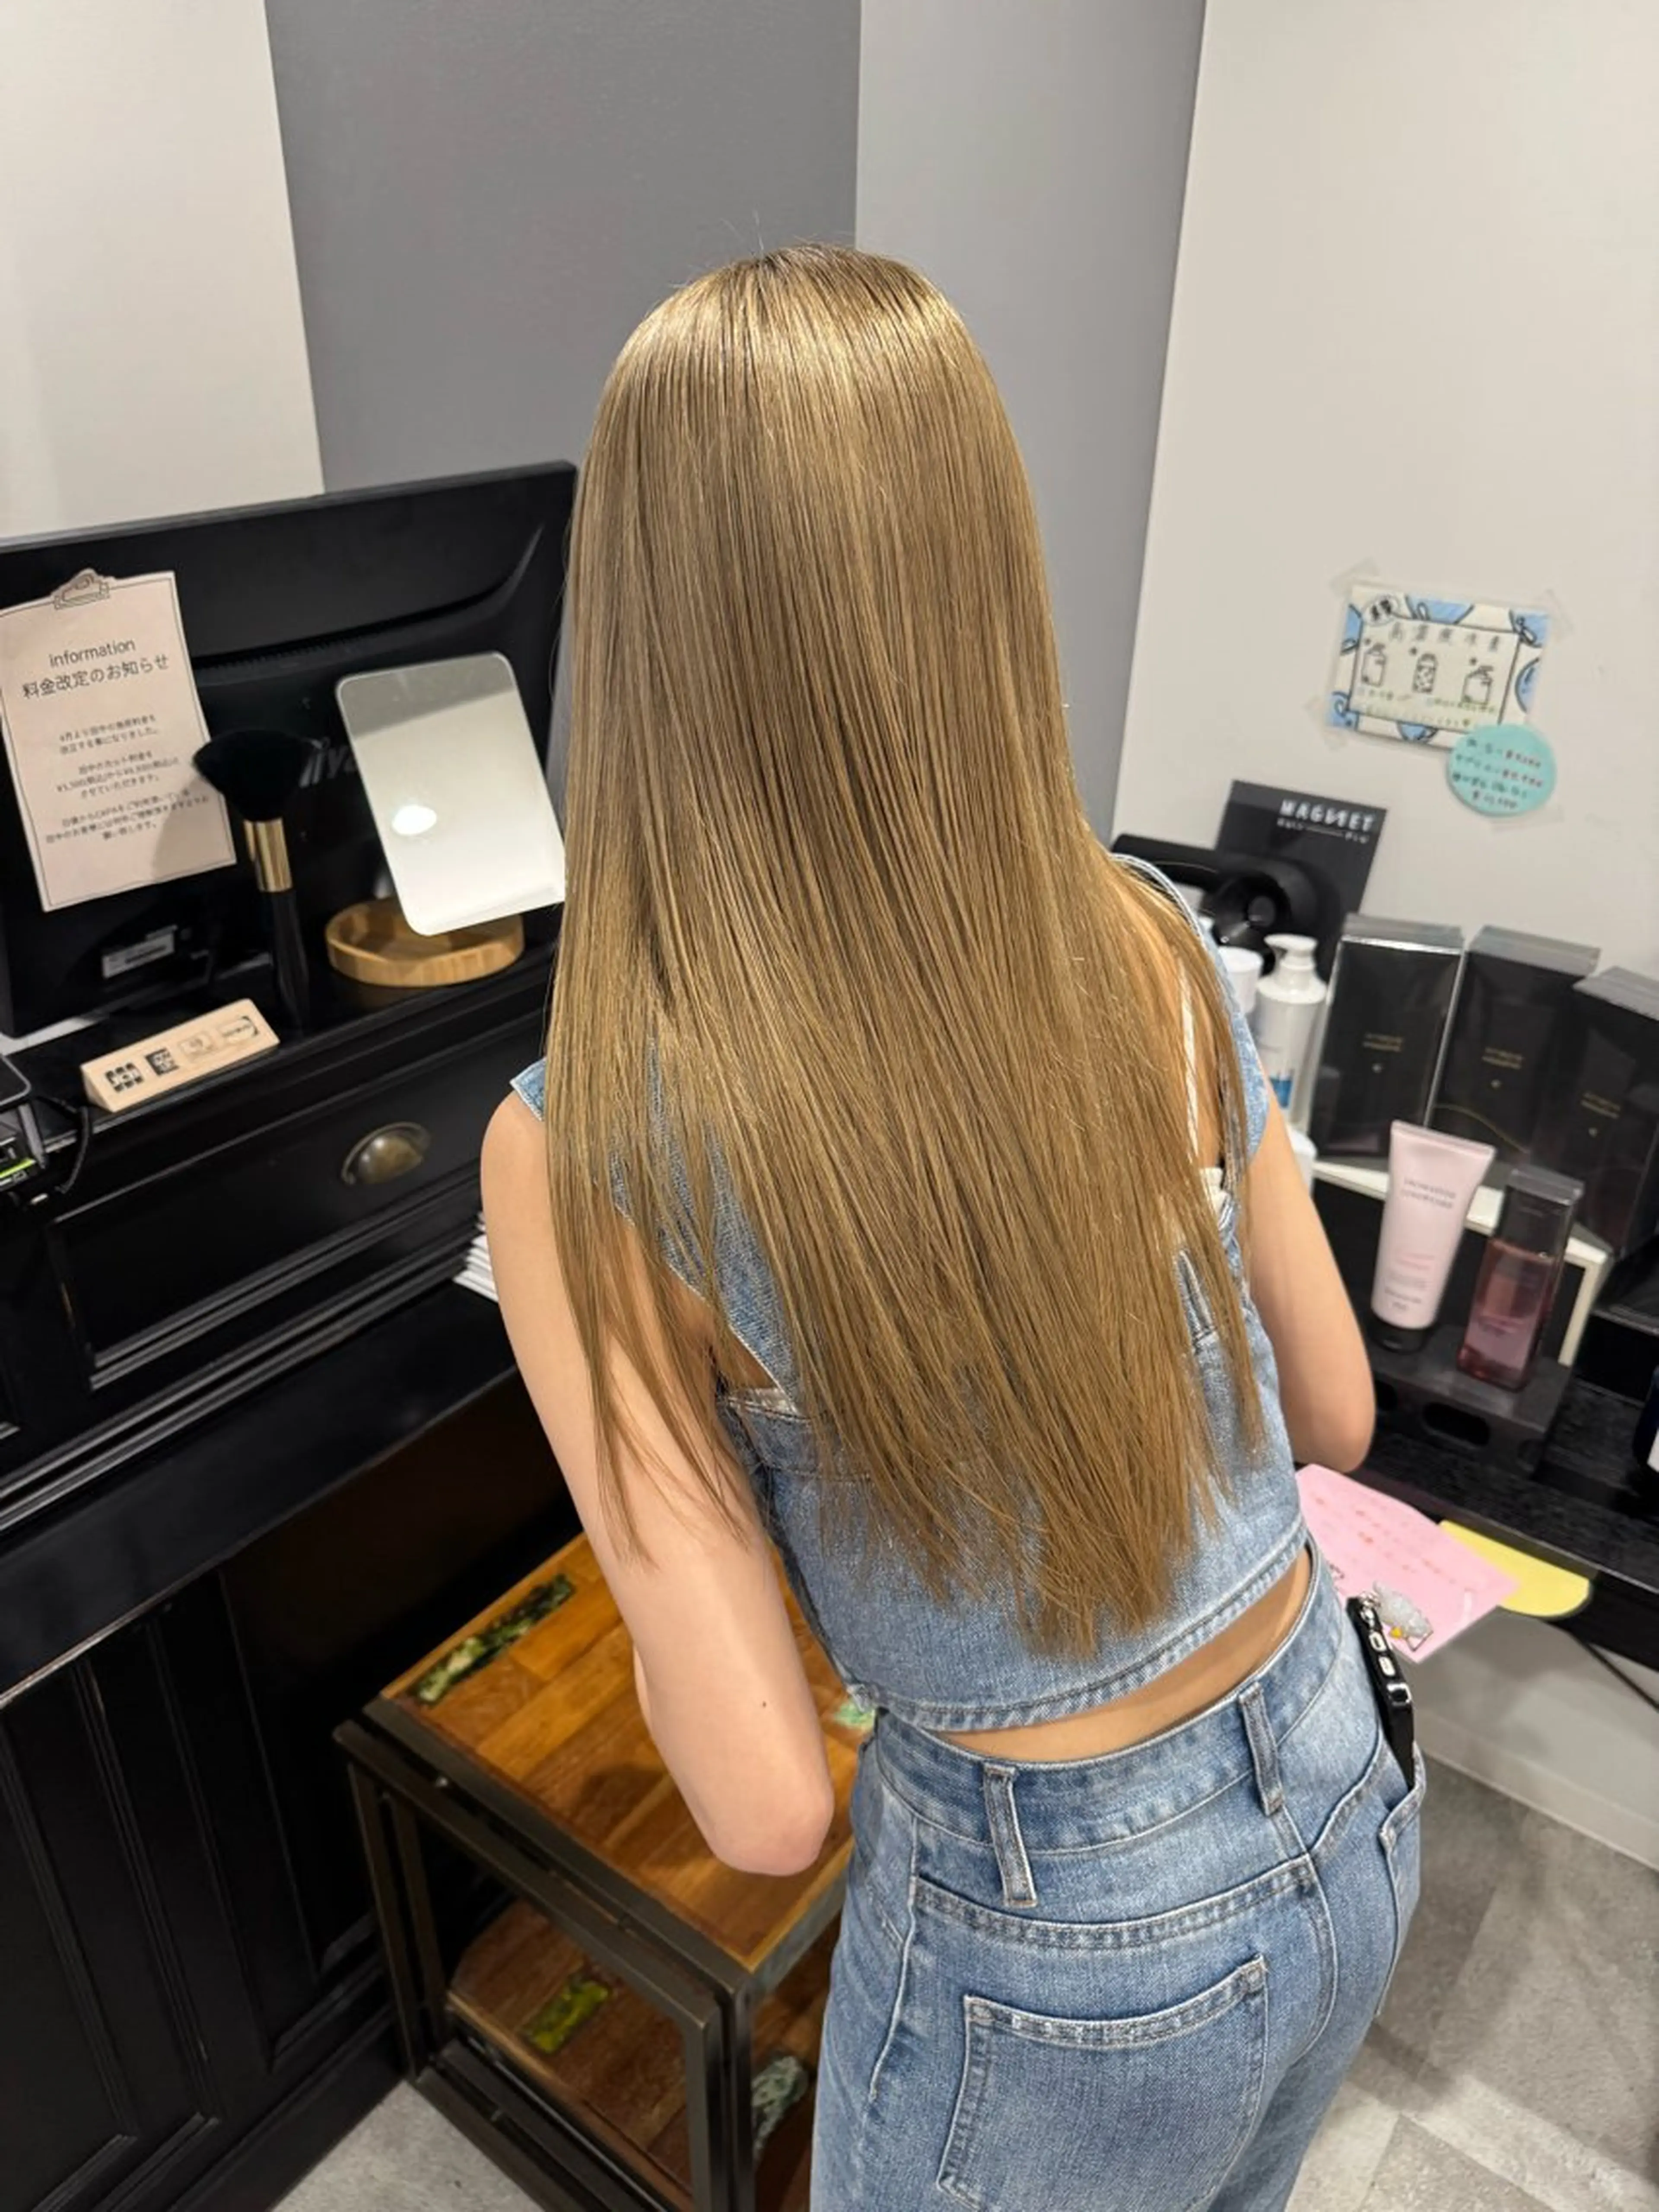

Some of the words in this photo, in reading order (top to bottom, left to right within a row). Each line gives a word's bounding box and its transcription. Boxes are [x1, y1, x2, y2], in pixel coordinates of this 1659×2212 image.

[49, 639, 136, 668] information
[22, 653, 169, 699] 料金改定のお知らせ
[1279, 799, 1374, 832] MAGNET
